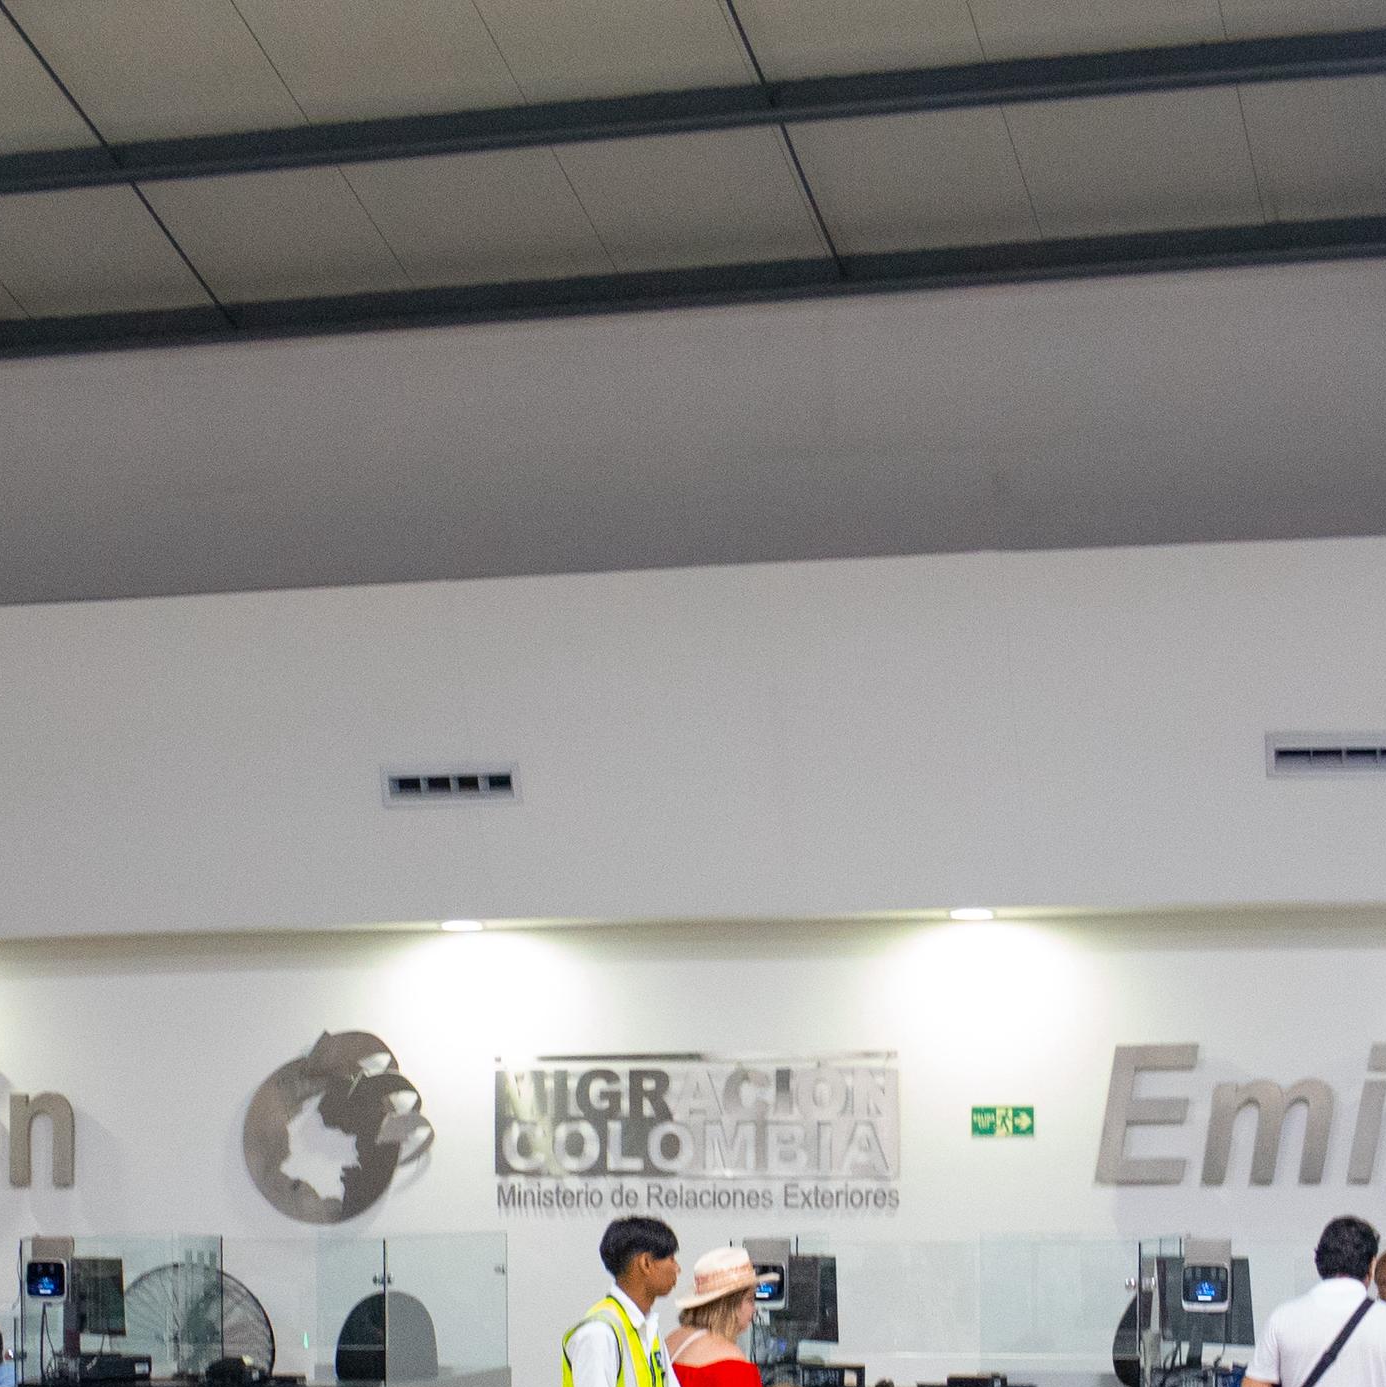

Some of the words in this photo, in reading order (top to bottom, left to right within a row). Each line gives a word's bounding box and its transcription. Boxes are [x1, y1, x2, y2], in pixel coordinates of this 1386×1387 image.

[500, 1119, 893, 1174] COLOMBIA
[496, 1183, 604, 1209] Ministerio
[613, 1183, 639, 1209] de
[647, 1183, 774, 1209] Relaciones
[784, 1183, 901, 1209] Exteriores
